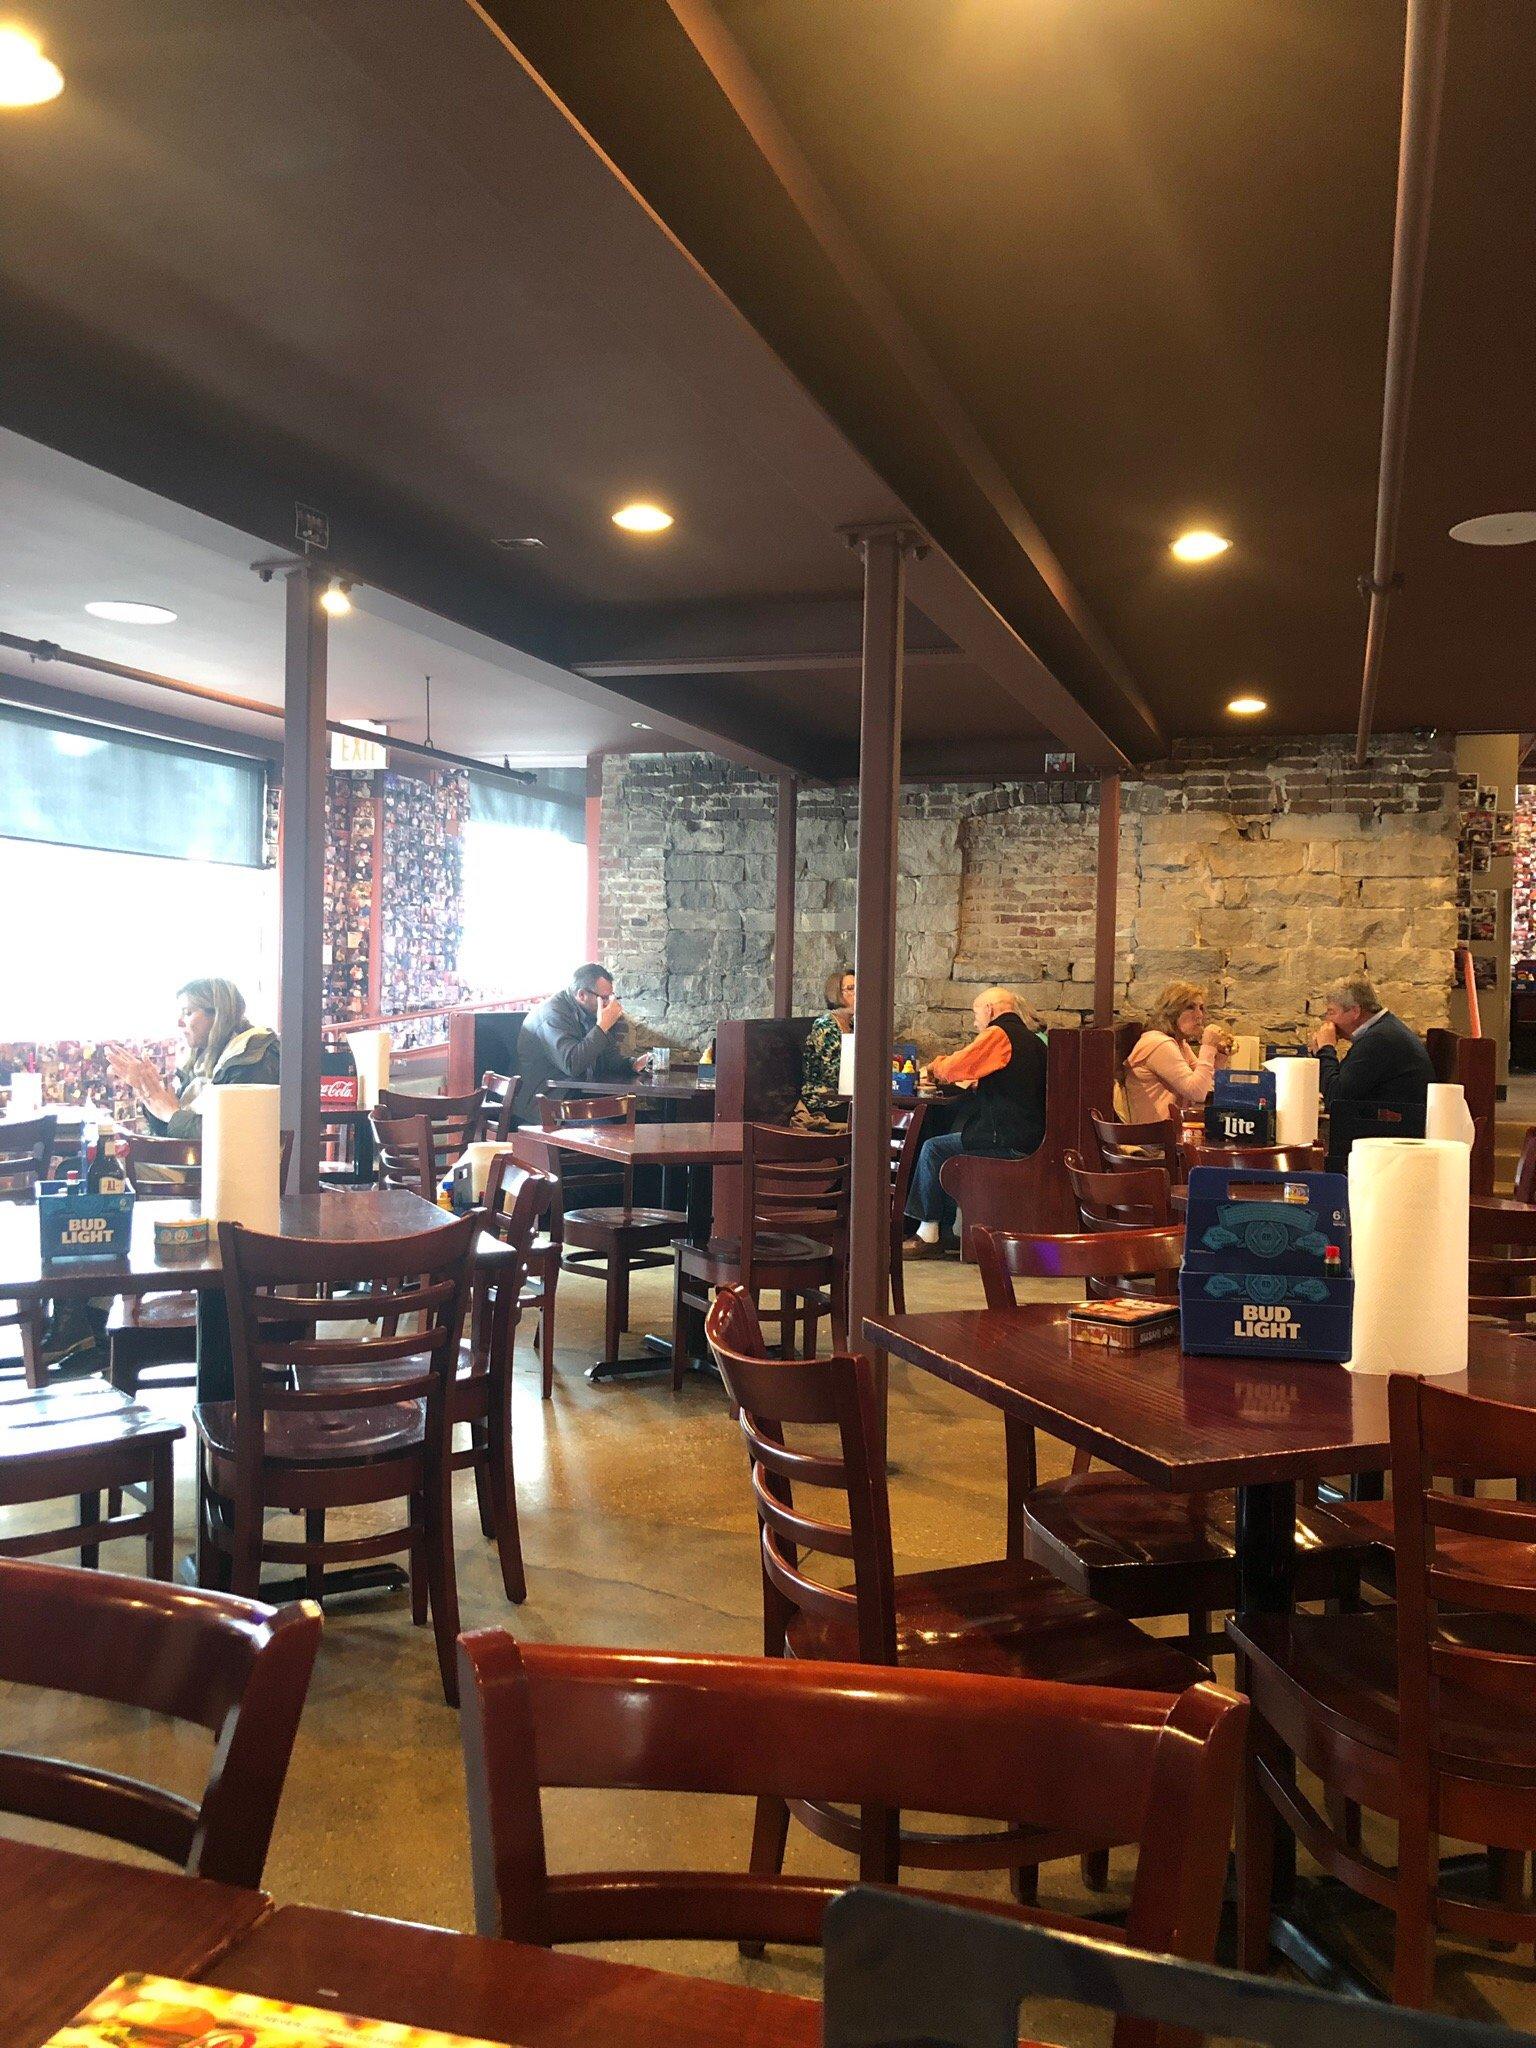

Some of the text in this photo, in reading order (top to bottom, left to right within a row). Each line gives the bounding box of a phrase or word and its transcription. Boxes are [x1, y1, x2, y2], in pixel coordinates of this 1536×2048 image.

[1224, 1116, 1255, 1138] Lite
[69, 1218, 107, 1231] BUD
[61, 1229, 114, 1244] LIGHT
[1243, 1304, 1291, 1322] BUD
[1234, 1320, 1301, 1339] LIGHT
